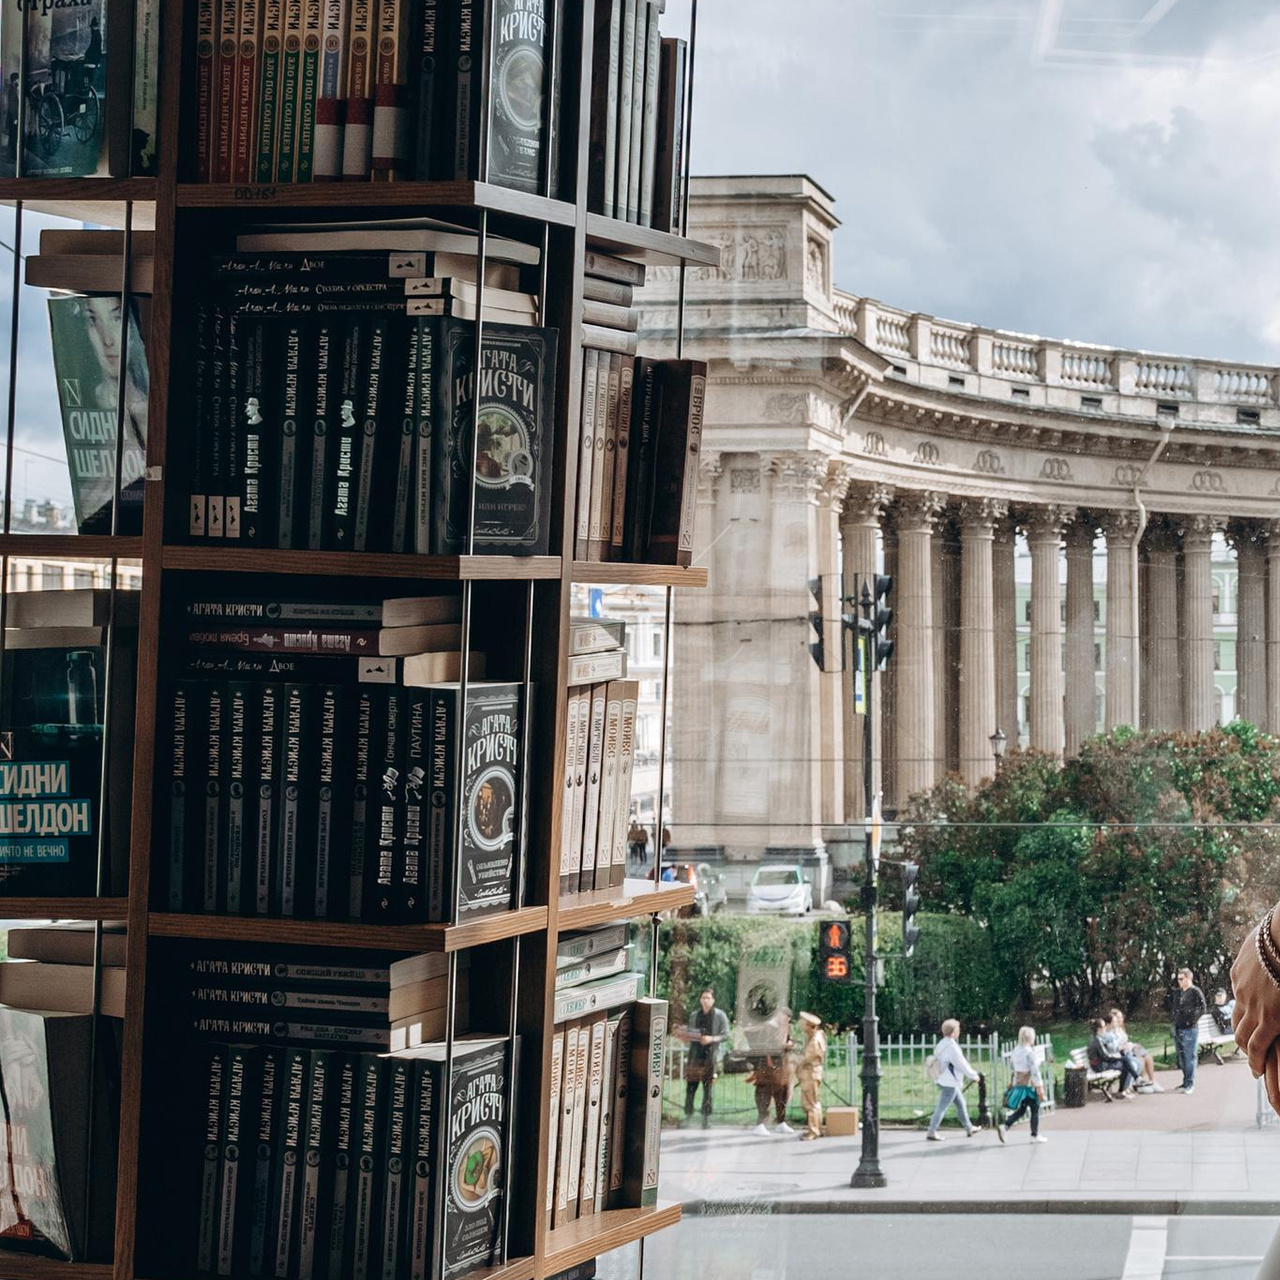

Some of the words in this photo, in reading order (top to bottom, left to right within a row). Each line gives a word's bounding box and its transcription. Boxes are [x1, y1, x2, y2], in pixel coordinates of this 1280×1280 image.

[500, 11, 546, 47] КРИСТ
[266, 56, 275, 76] ЗЛО
[287, 56, 295, 76] ЗЛО
[306, 56, 315, 76] ЗЛО
[241, 64, 250, 103] ДЕСЯТЬ
[264, 78, 274, 101] ПОД
[285, 78, 295, 101] ПОД
[303, 79, 314, 101] ПОД
[239, 105, 248, 160] НЕГРИТЯТ
[261, 103, 273, 154] СОЛНЦЕМ
[282, 103, 293, 154] СОЛНЦЕМ
[301, 102, 313, 154] СОЛНЦЕМ
[480, 349, 517, 373] ГАТА
[245, 434, 261, 474] Кристи
[336, 436, 352, 477] Кристи
[244, 479, 259, 513] Агата
[334, 481, 350, 516] Агата
[386, 696, 397, 730] смерти
[411, 702, 422, 758] ПАУТИНА
[481, 713, 511, 738] АГАТА
[384, 731, 397, 763] Гончая
[0, 764, 67, 798] ИДНИ
[378, 805, 395, 846] Кристи
[404, 805, 422, 845] Кристи
[24, 845, 34, 858] НЕ
[37, 845, 65, 858] ВЕЧНО
[377, 850, 393, 885] Агата
[403, 850, 418, 884] Агата
[196, 960, 228, 974] АГАТА
[231, 961, 271, 977] КРИСТИ
[197, 988, 228, 1001] АГАТА
[230, 989, 268, 1005] КРИСТИ
[200, 1018, 230, 1032] АГАТА
[232, 1020, 270, 1035] КРИСТИ
[466, 1074, 497, 1102] АГАТА
[451, 1092, 503, 1143] КРИСТ
